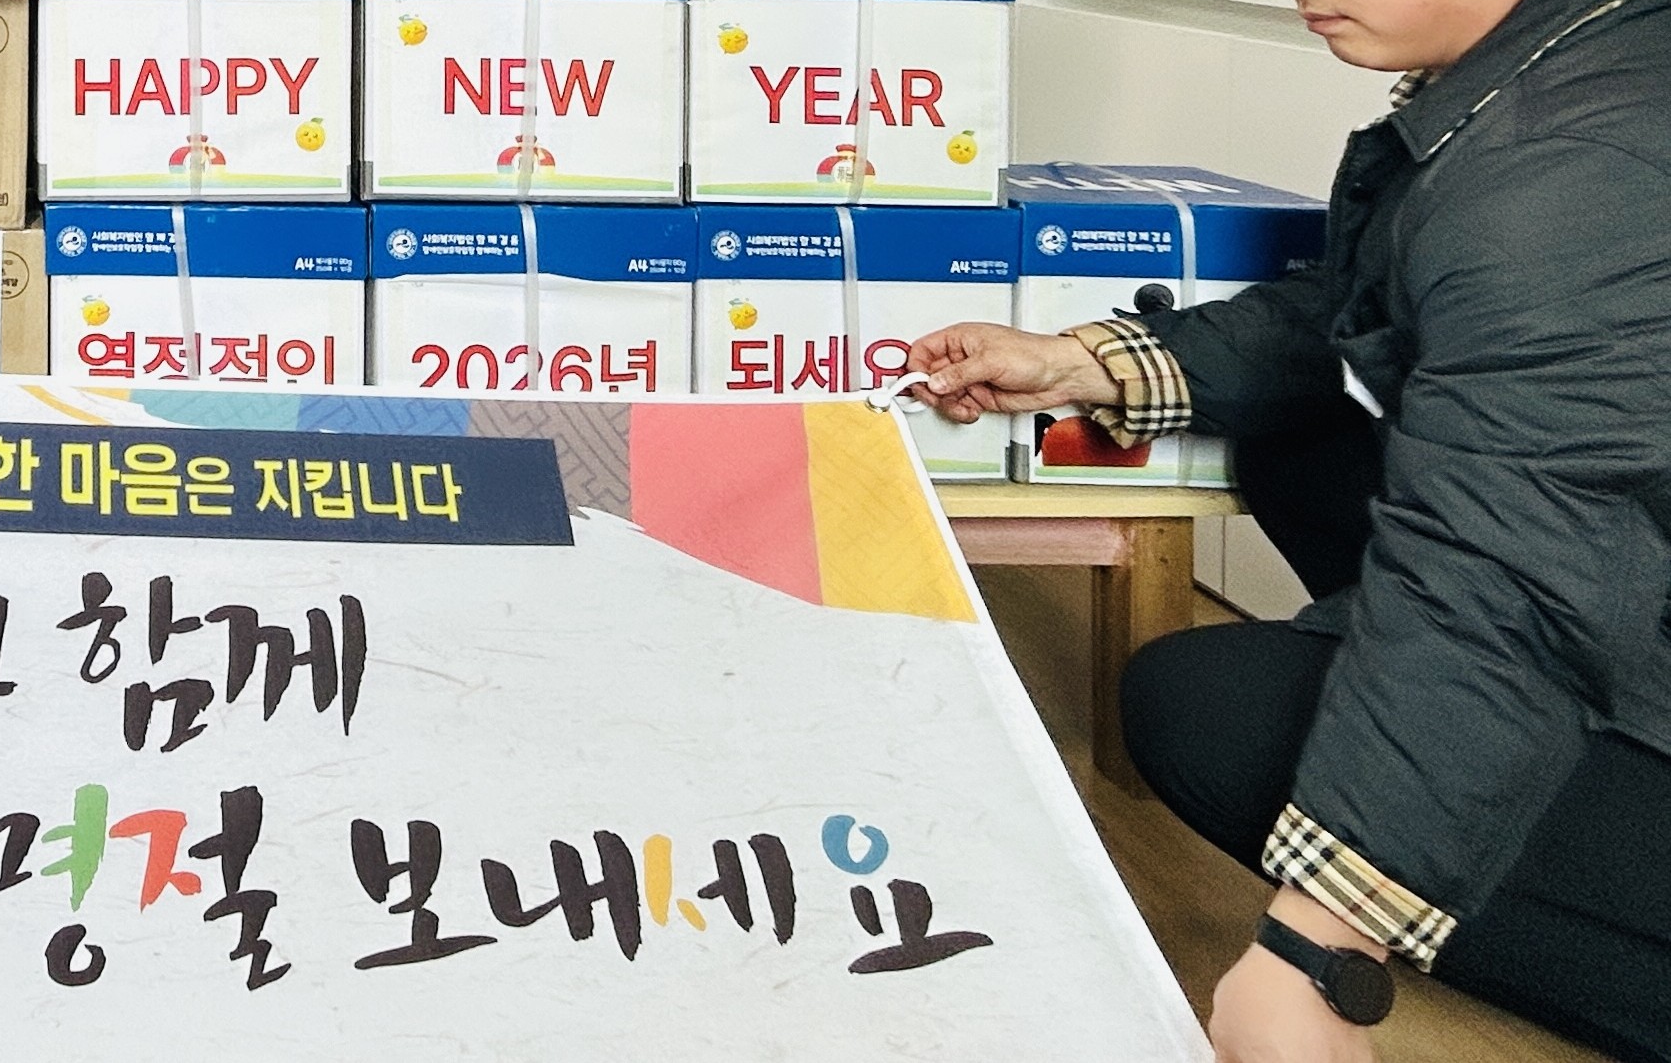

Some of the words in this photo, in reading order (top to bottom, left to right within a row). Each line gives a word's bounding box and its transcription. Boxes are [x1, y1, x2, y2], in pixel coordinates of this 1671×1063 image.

[73, 57, 321, 117] HAPPY
[442, 57, 616, 117] NEW
[748, 66, 947, 128] YEAR
[294, 257, 315, 271] A4
[628, 258, 649, 273] A4
[950, 260, 971, 274] A4
[59, 439, 236, 517] 마음은
[253, 458, 463, 524] 지킵니다
[56, 571, 368, 755] 함께
[350, 813, 995, 975] 보내세요
